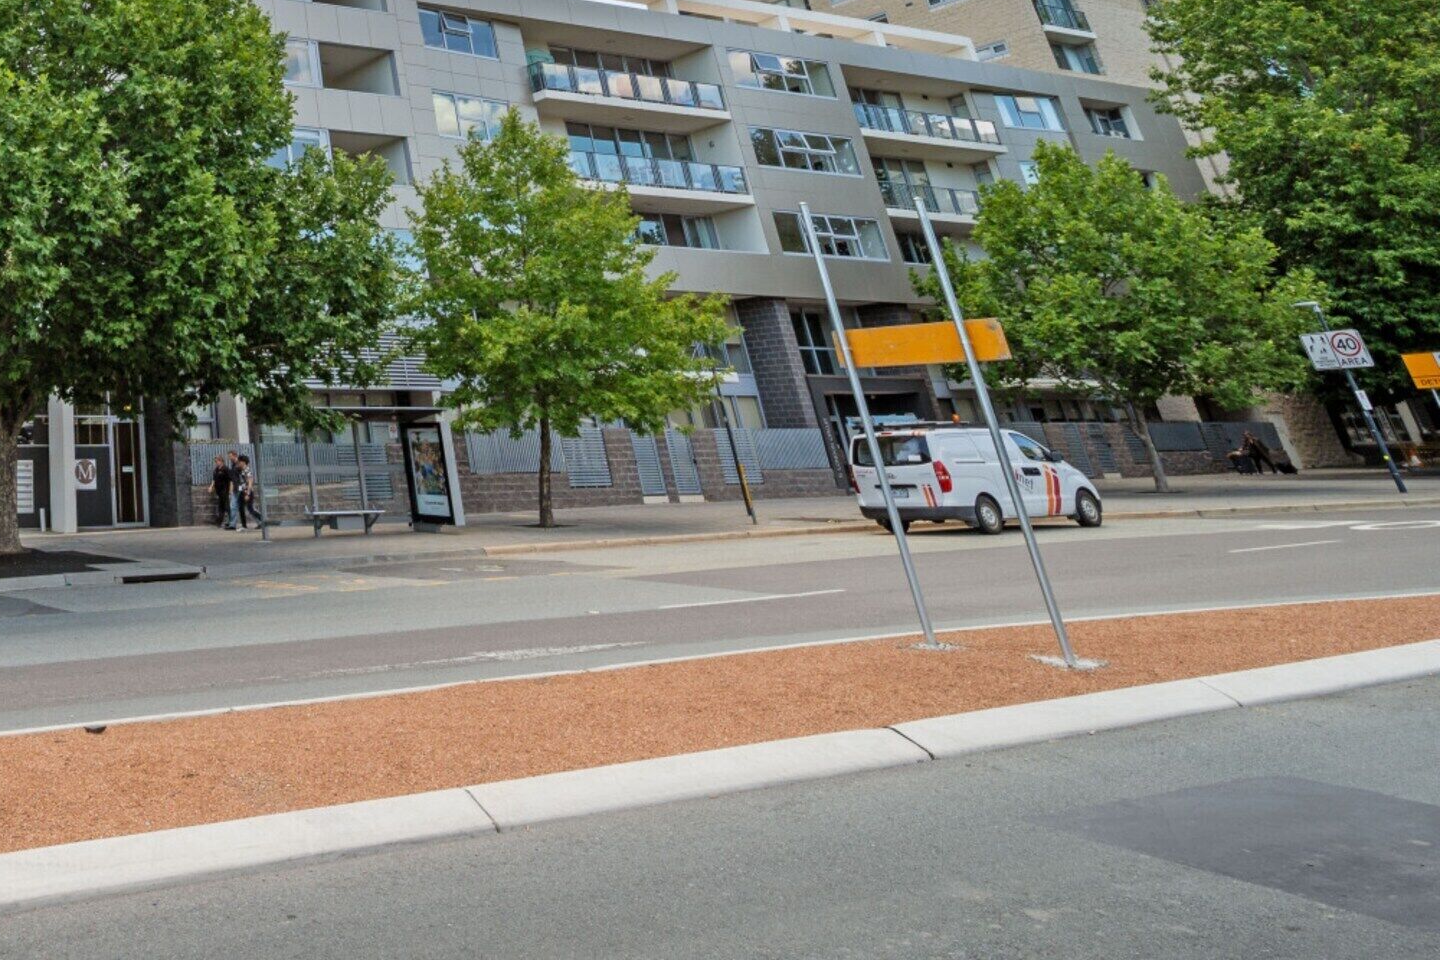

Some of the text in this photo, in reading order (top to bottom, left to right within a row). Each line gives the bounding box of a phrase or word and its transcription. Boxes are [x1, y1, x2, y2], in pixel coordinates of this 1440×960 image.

[1337, 337, 1357, 351] 40
[1341, 357, 1368, 366] AREA
[1421, 378, 1440, 386] DET
[78, 464, 93, 480] M
